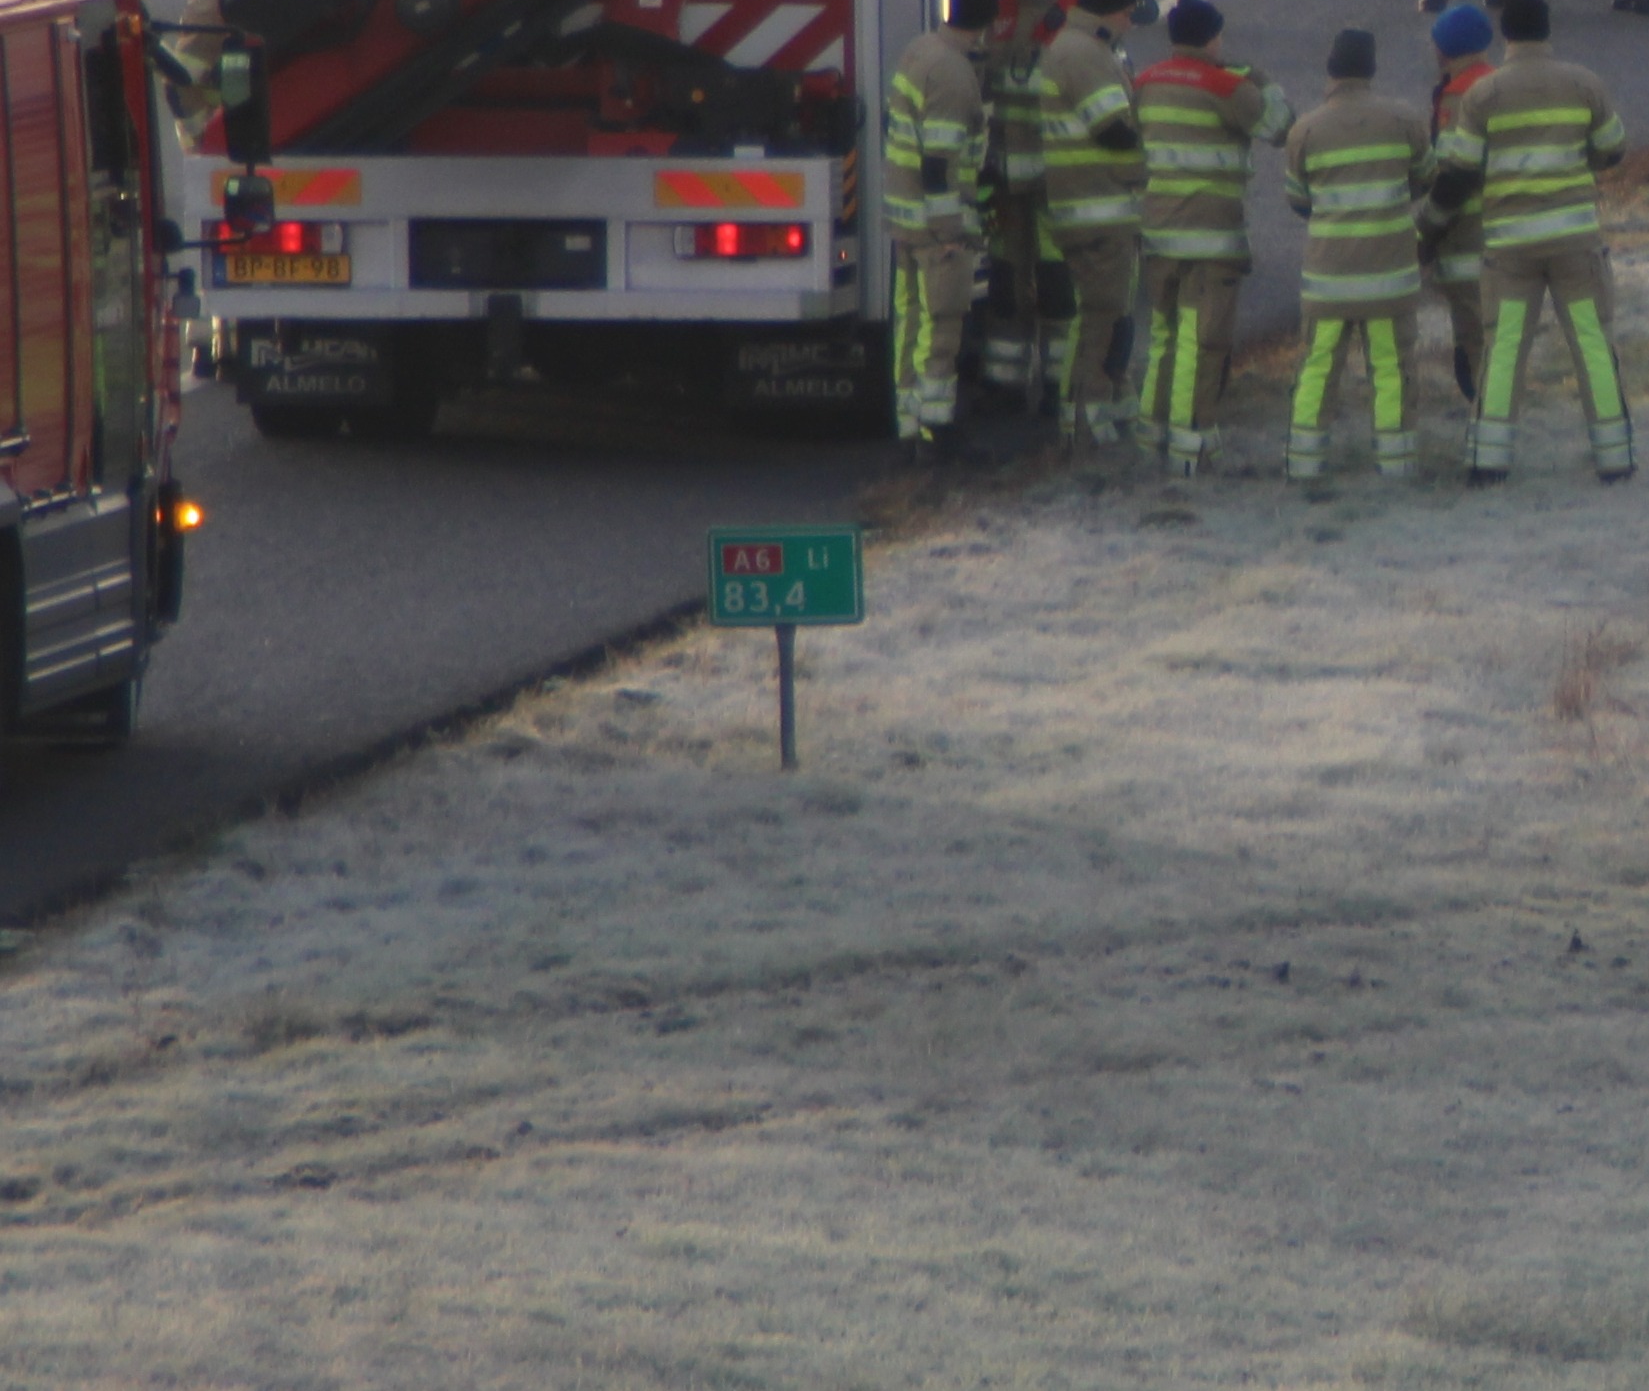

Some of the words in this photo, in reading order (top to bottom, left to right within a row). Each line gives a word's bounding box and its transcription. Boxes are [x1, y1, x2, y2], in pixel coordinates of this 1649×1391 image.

[266, 375, 366, 393] ALMELO
[753, 378, 855, 398] ALMELO
[733, 548, 771, 573] A6
[723, 580, 806, 616] 83,4
